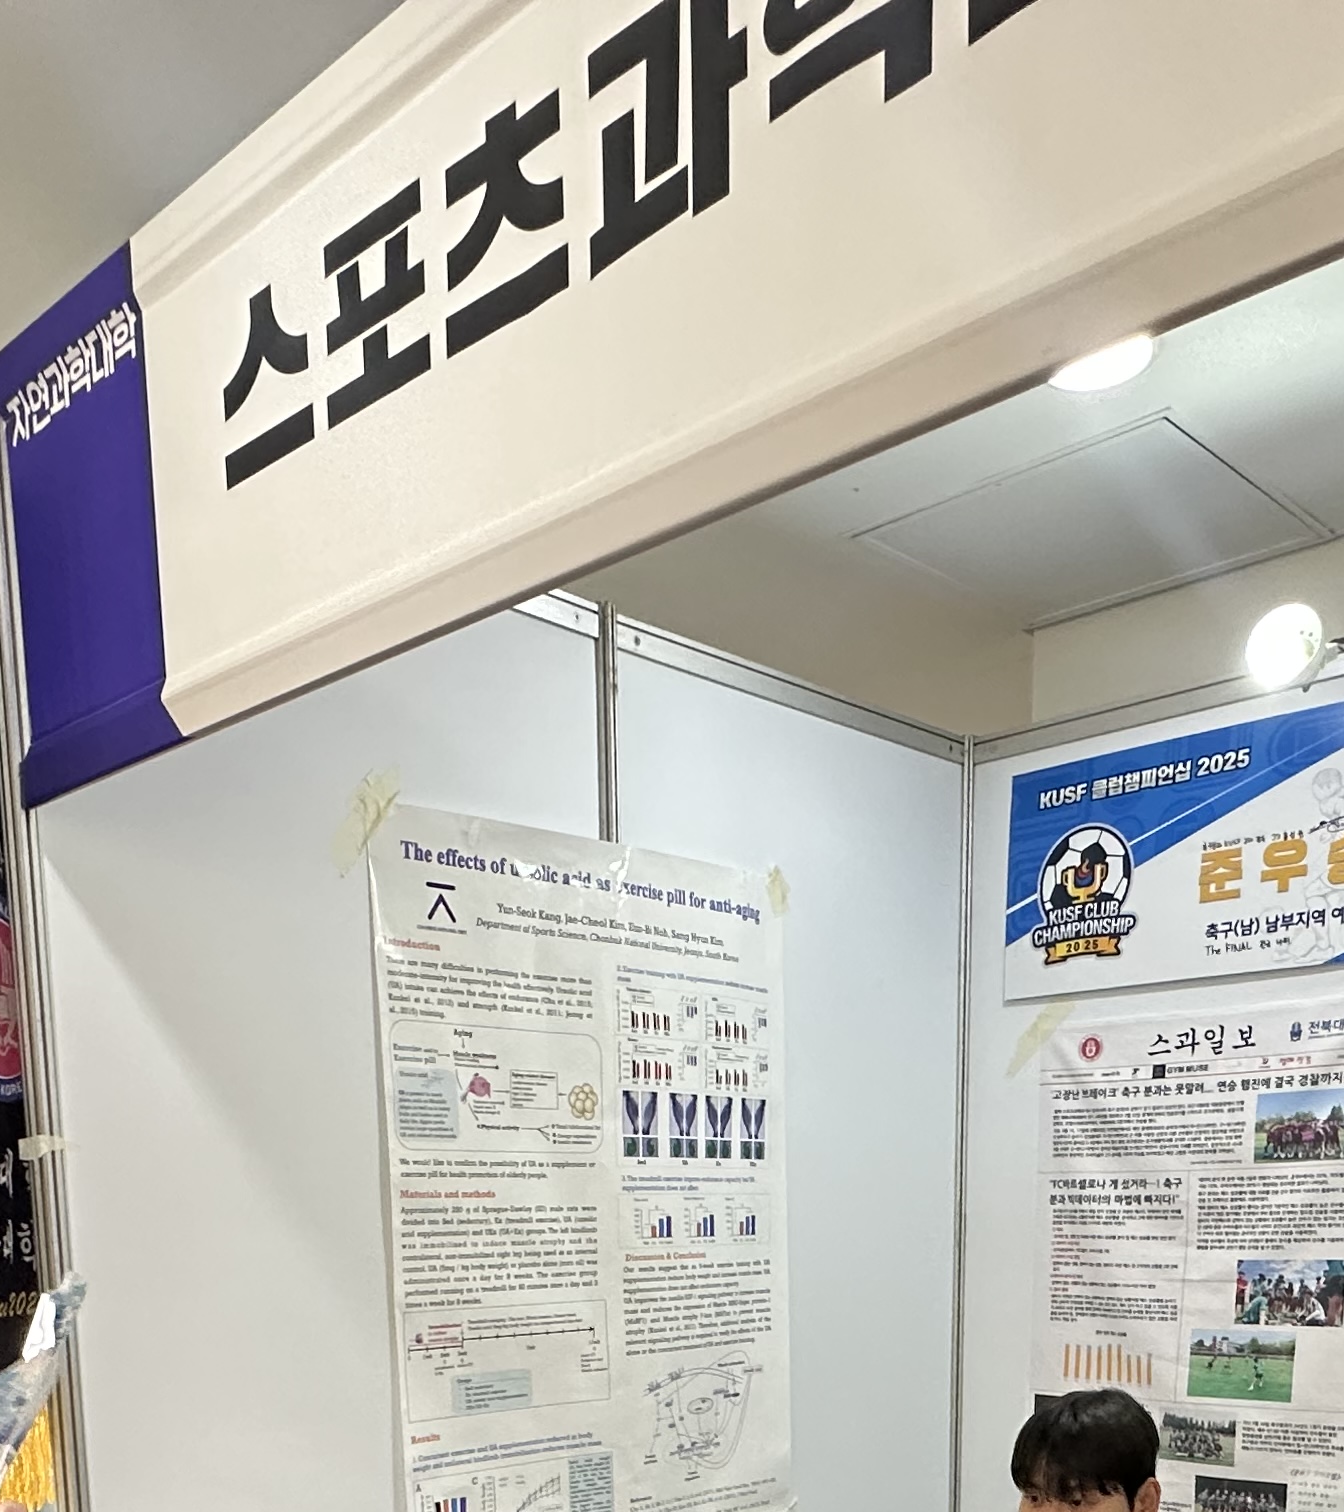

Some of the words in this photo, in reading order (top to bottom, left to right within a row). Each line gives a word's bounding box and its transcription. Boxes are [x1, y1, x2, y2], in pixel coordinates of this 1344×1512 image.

[224, 0, 1044, 490] 스포츠과
[6, 302, 137, 447] 자연과학대학
[1039, 784, 1088, 810] KUSF
[1091, 760, 1191, 800] 클럽챔피언십
[1196, 748, 1250, 777] 2025
[400, 840, 433, 863] The
[437, 848, 486, 872] effects
[490, 857, 508, 875] of
[510, 863, 558, 884] uolic
[596, 877, 611, 892] as
[618, 881, 664, 902] xercise
[666, 888, 687, 908] pill
[689, 892, 707, 909] for
[709, 898, 761, 926] anti-aging
[476, 916, 521, 934] Department
[522, 923, 531, 934] of
[531, 924, 556, 938] Sports
[1049, 906, 1083, 926] KUSF
[1084, 901, 1119, 919] CLUB
[1205, 918, 1260, 940] 축구(남)
[1265, 909, 1326, 934] 남부지역
[1034, 915, 1135, 946] CHAMPIONSHIP
[399, 1189, 442, 1199] Materials
[444, 1189, 459, 1198] and
[461, 1189, 496, 1199] methods
[410, 1433, 441, 1445] Results
